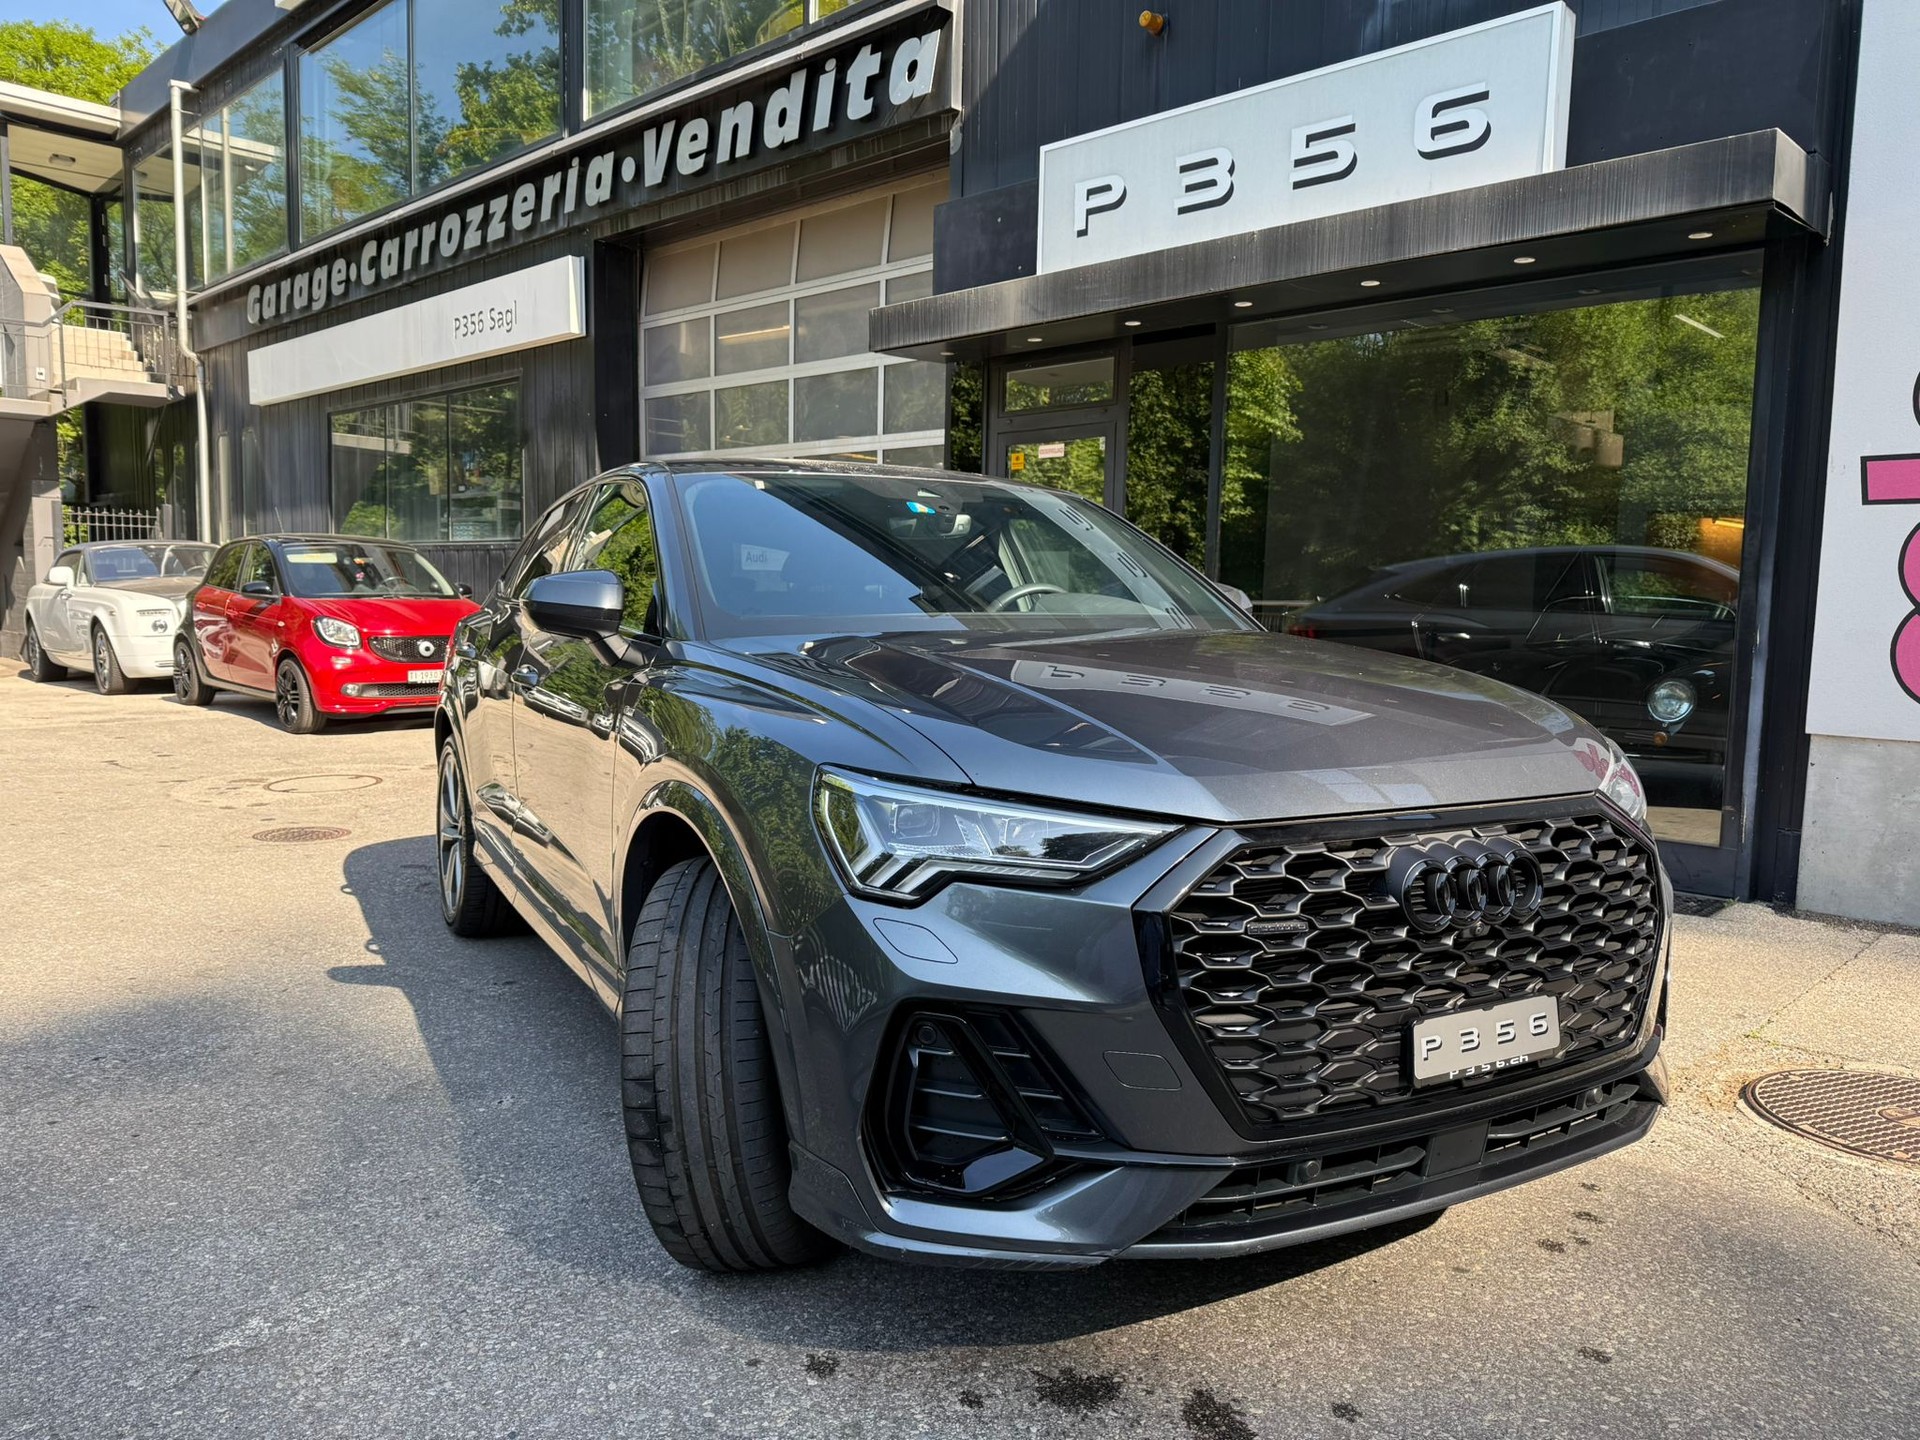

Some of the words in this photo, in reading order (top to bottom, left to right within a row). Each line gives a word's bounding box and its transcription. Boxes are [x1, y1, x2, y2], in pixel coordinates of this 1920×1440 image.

[454, 310, 484, 340] P356
[489, 300, 517, 333] Sagl
[746, 551, 768, 562] Audi
